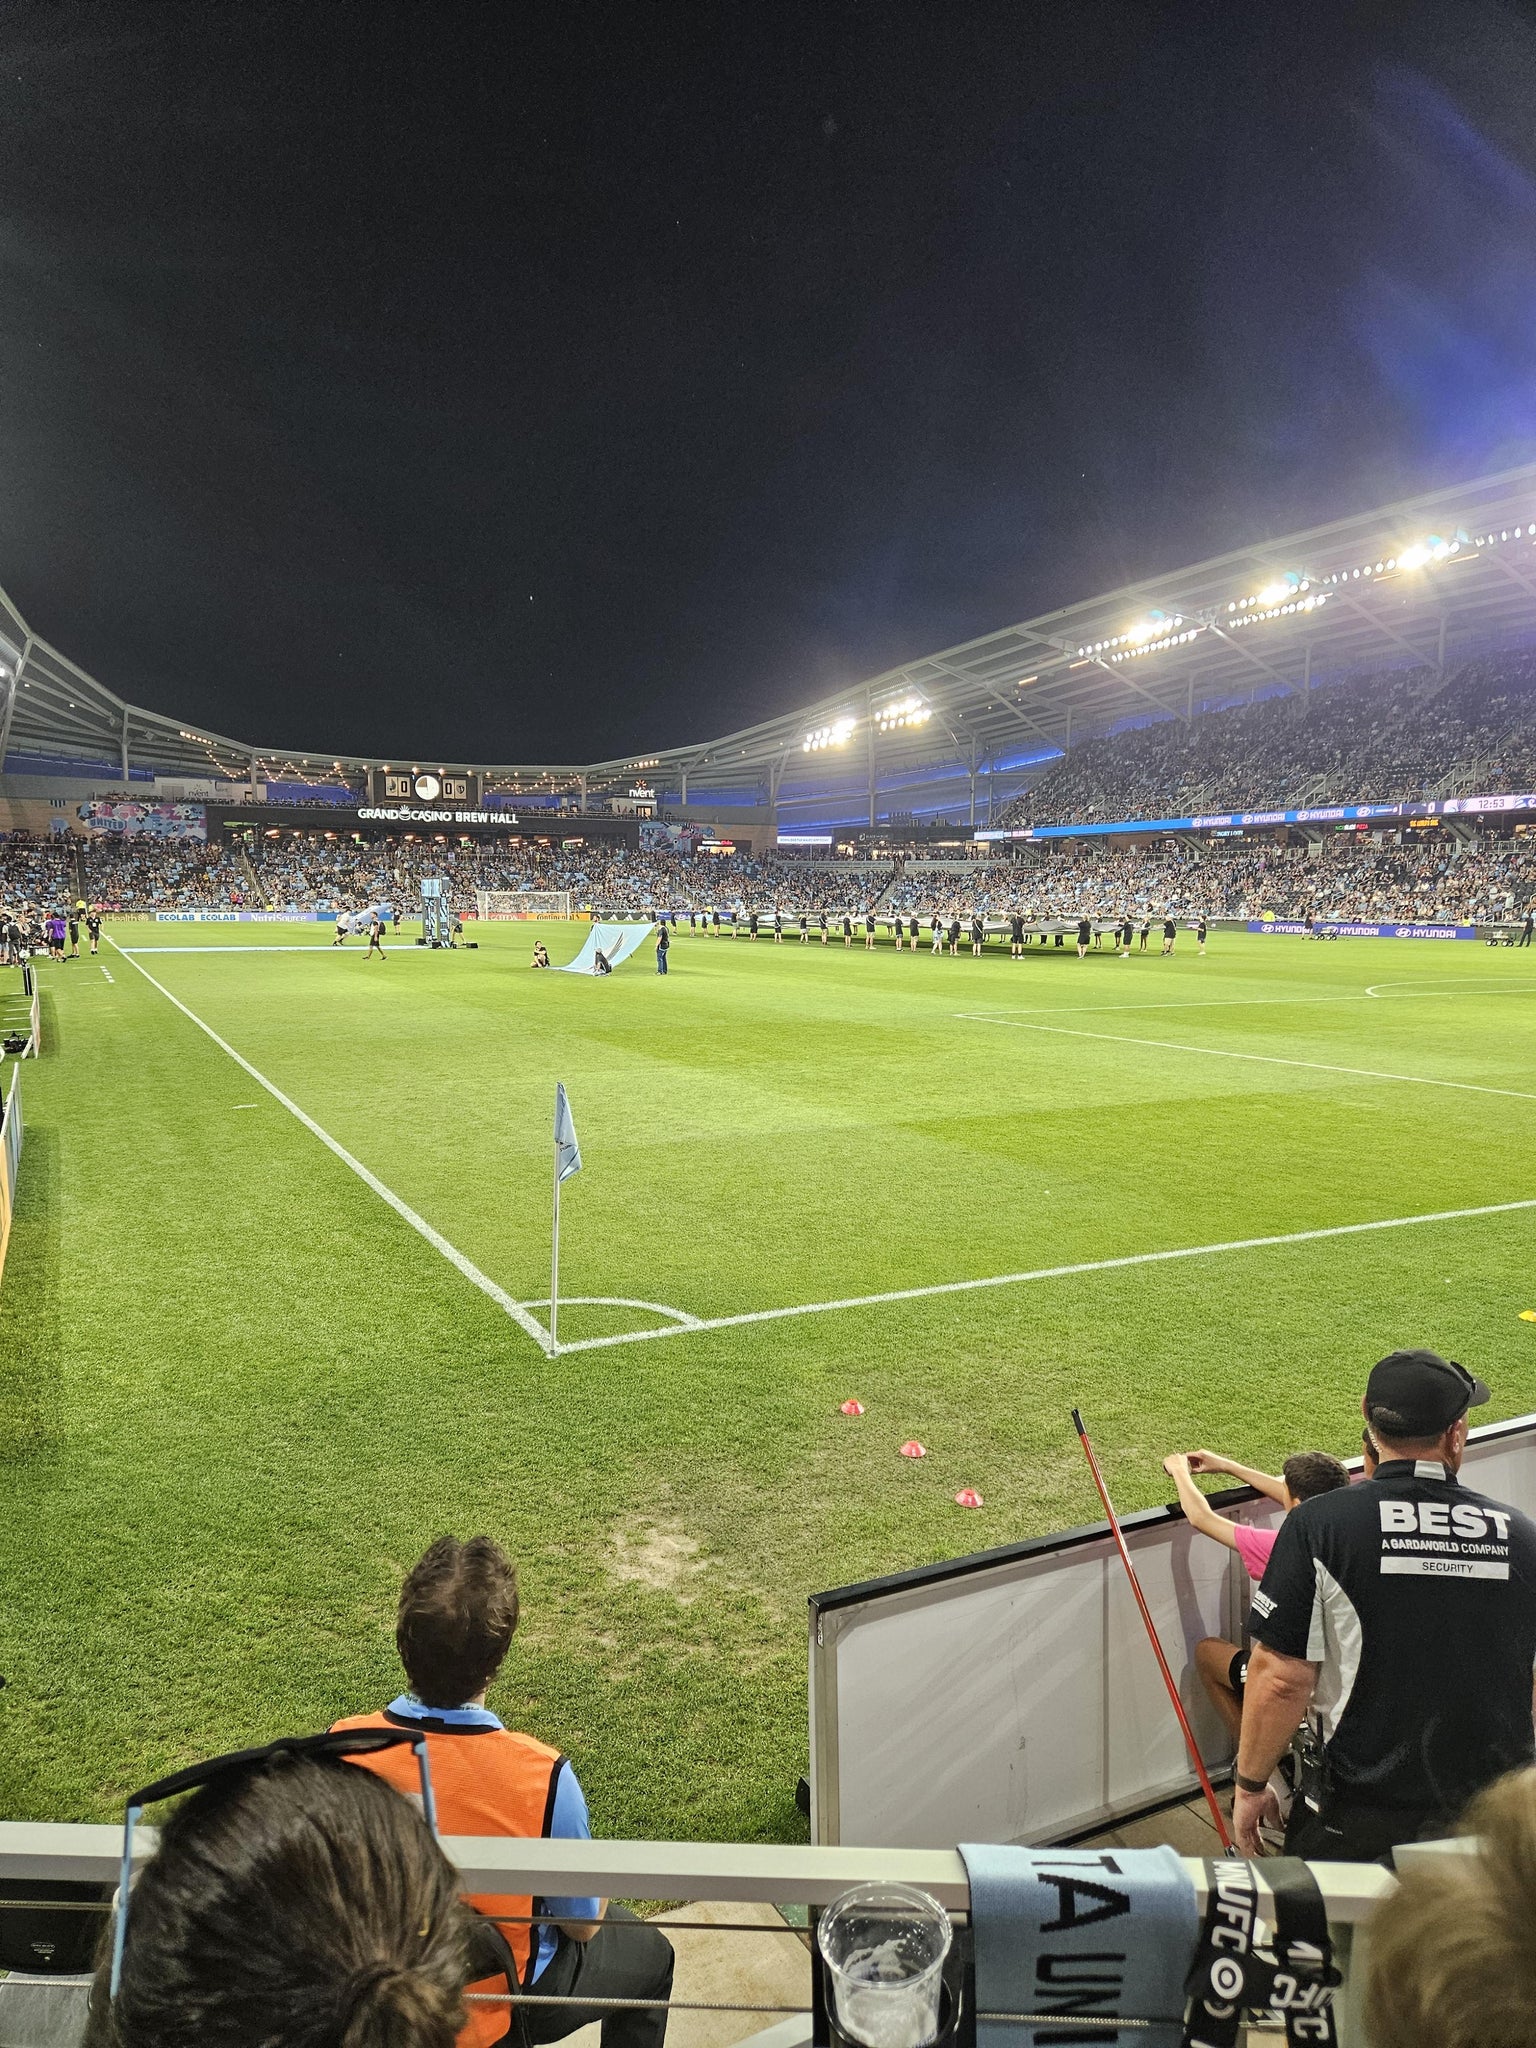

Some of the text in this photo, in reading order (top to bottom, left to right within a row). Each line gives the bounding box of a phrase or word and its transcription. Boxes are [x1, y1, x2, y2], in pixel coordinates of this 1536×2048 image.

[400, 780, 408, 793] 0
[445, 782, 453, 795] 0
[1478, 798, 1505, 809] 12:53
[357, 808, 519, 824] GRAND CASINO BREW HALL
[1253, 812, 1285, 823] HYUNDAI
[1309, 809, 1344, 819] HYUNDAI
[89, 818, 124, 830] UNITED
[1202, 816, 1231, 826] HYUNDAI
[106, 913, 137, 922] Health
[158, 913, 195, 921] ECOLAB
[200, 913, 236, 921] ECOLAB
[250, 913, 306, 922] NutriSource
[1340, 926, 1379, 936] HYUNDAI
[1413, 928, 1456, 939] HYUNDAI
[1379, 1501, 1511, 1540] BEST
[1381, 1538, 1509, 1556] A GARDAWORLD COMPANY
[1422, 1562, 1473, 1573] SECURITY
[1254, 1590, 1278, 1611] BEST
